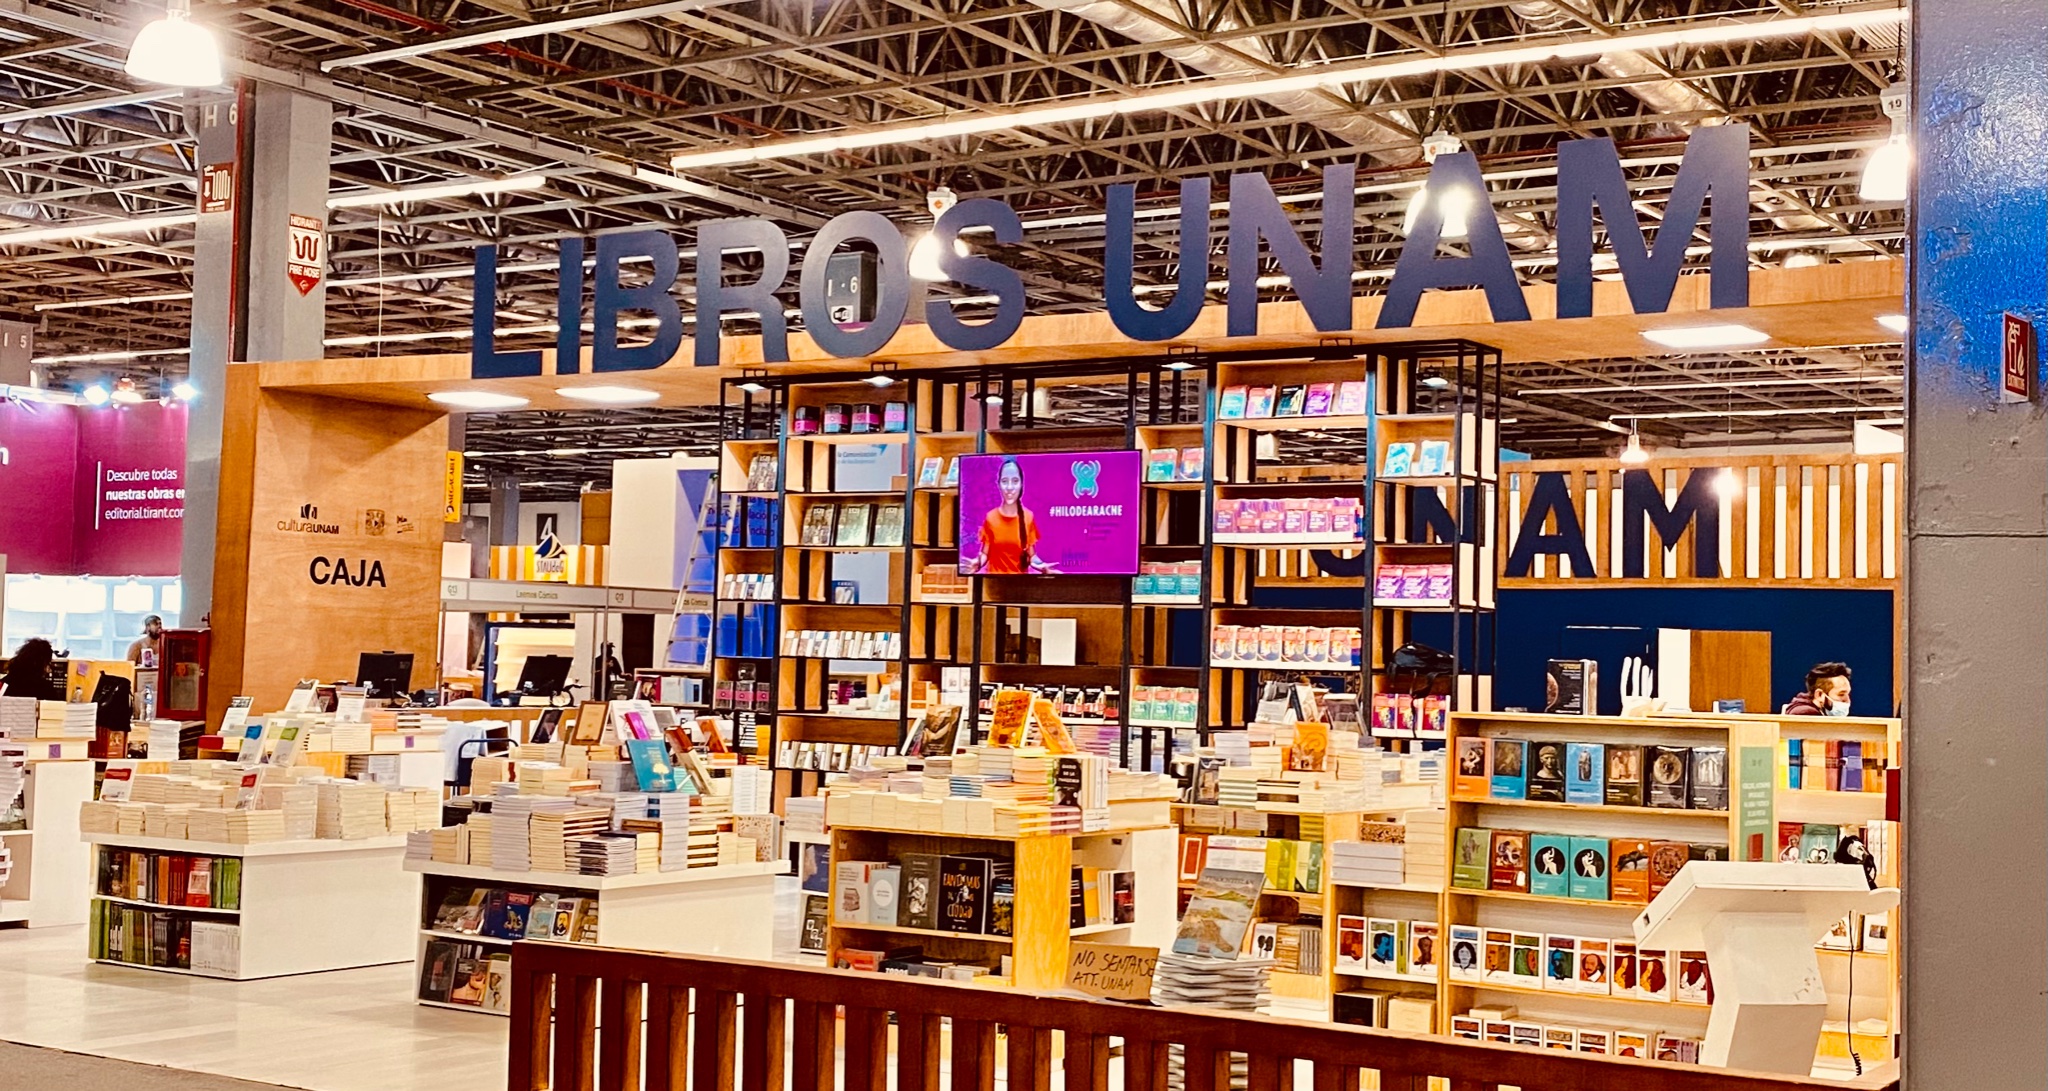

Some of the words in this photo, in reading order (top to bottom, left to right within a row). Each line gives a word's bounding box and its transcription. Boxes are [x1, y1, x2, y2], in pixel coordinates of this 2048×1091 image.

[471, 198, 1026, 379] LIBROS
[1104, 123, 1749, 341] UNAM
[288, 263, 303, 276] FIRE
[303, 265, 320, 279] HOSE
[106, 468, 150, 482] Descubre
[151, 467, 178, 480] todas
[105, 487, 146, 501] nuestras
[147, 487, 171, 500] obras
[540, 516, 552, 540] 4
[309, 556, 387, 588] CAJA
[1072, 949, 1096, 968] NO
[1099, 952, 1159, 978] SENTARSE
[1100, 975, 1134, 995] UNAM
